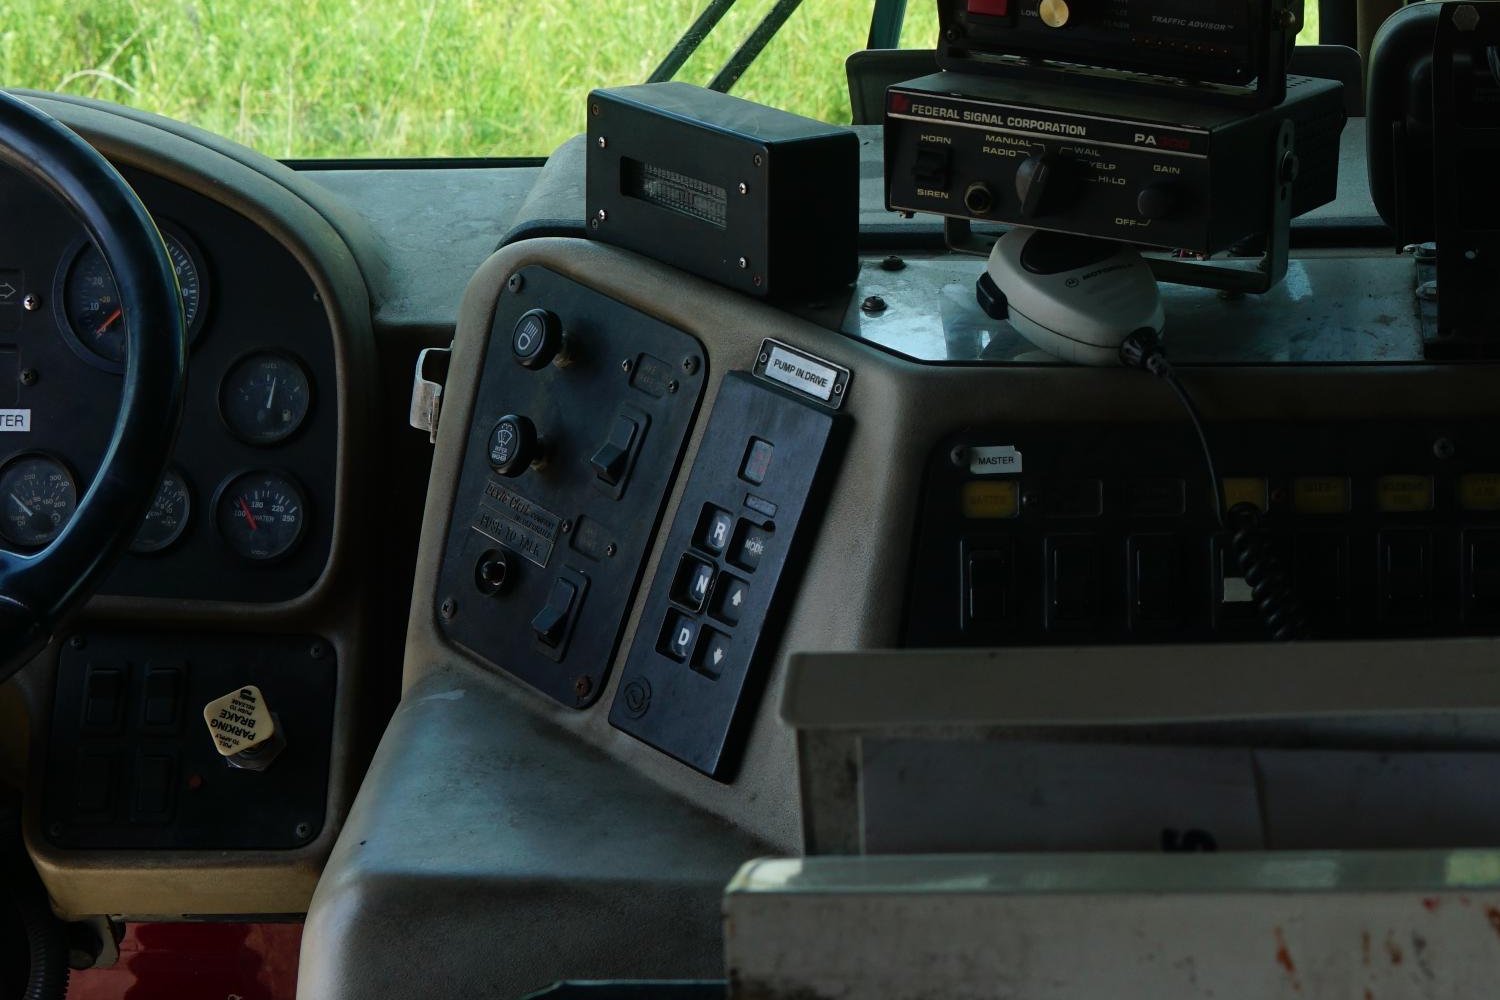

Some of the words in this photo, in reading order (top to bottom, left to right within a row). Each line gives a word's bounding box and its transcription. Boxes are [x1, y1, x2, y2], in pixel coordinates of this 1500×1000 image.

[1152, 15, 1186, 26] TRAFFIC
[912, 104, 960, 119] FEDERAL
[964, 111, 1004, 126] SIGNAL
[1007, 117, 1087, 136] CORPORATION
[920, 134, 952, 145] HORN
[985, 134, 1032, 148] MANUAL
[982, 146, 1016, 158] RADIO
[1074, 146, 1101, 157] WAIL
[1090, 161, 1117, 171] YELP
[1153, 164, 1181, 175] GAIN
[917, 188, 949, 200] SIREN
[1115, 217, 1137, 226] OFF
[774, 358, 796, 374] PUMP
[804, 371, 828, 388] DRIVE
[978, 456, 1015, 465] MASTER
[480, 514, 503, 536] PUSH
[520, 536, 539, 556] TALK
[714, 522, 726, 540] R
[745, 539, 764, 554] MODE
[696, 575, 709, 593] N
[678, 628, 690, 646] D
[220, 708, 256, 728] BRAKE
[210, 718, 256, 740] PARKING
